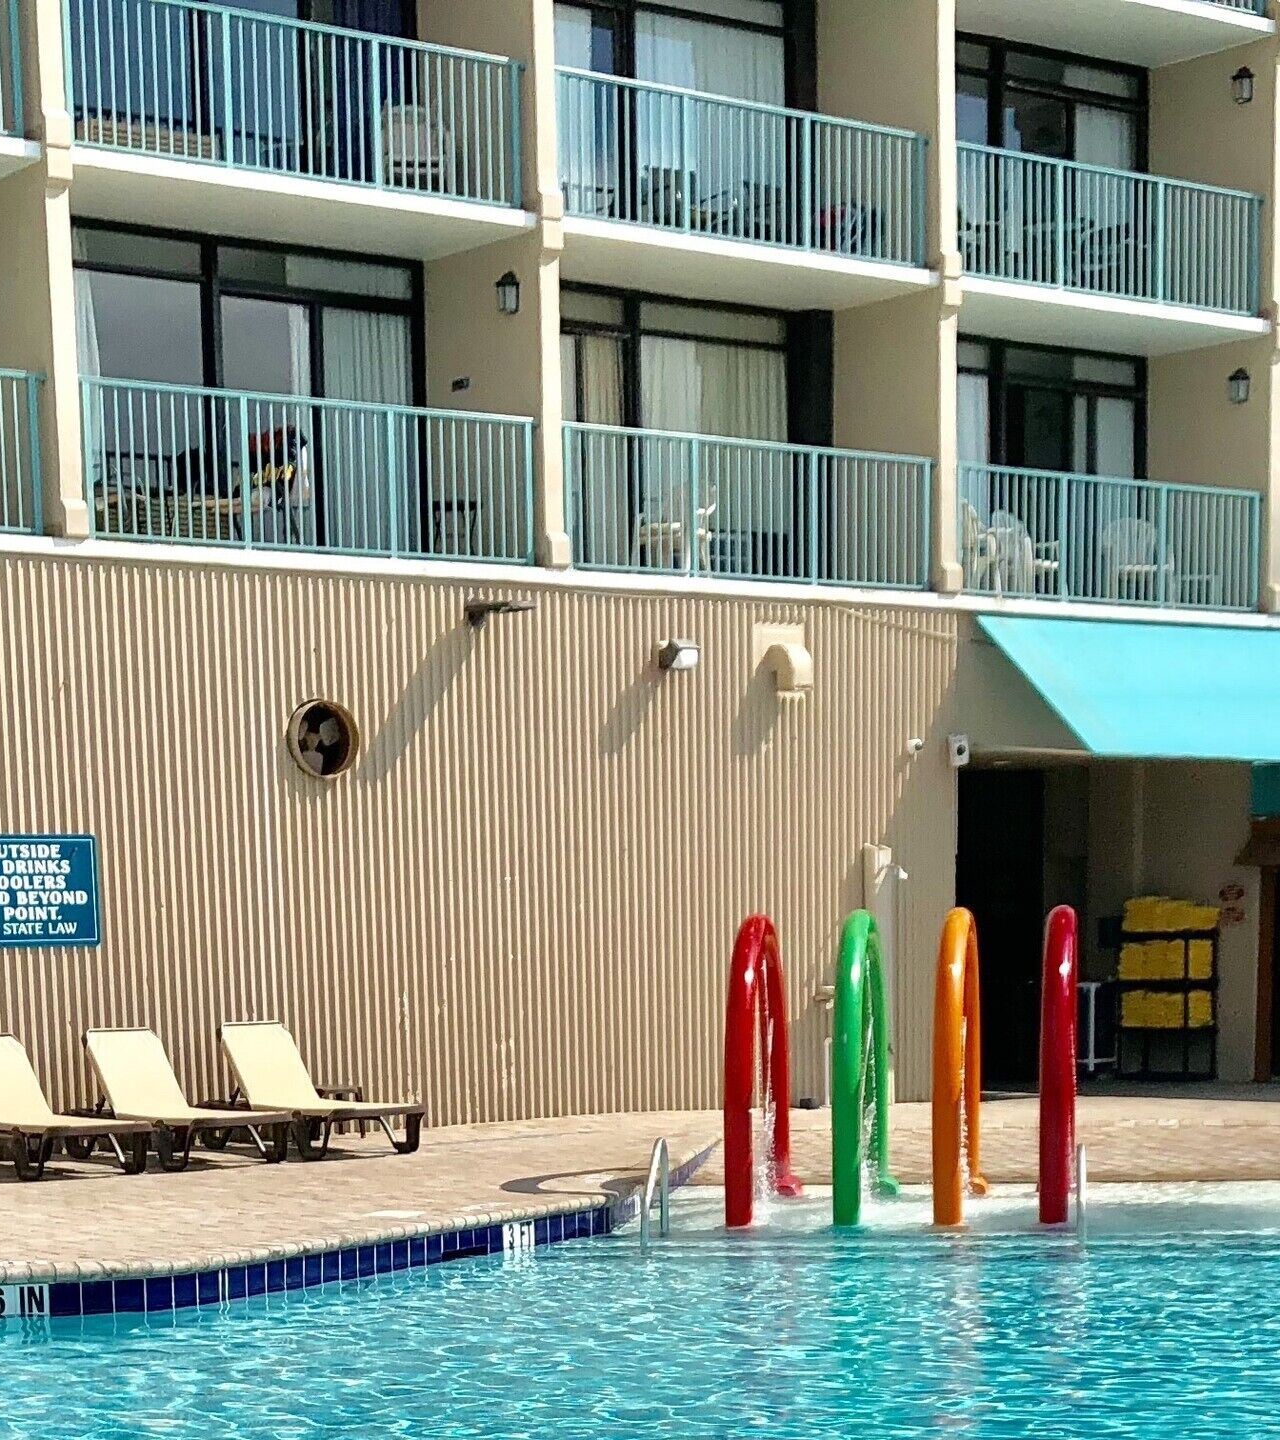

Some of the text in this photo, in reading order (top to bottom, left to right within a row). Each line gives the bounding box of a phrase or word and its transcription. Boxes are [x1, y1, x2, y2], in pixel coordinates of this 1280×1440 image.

[2, 859, 71, 875] DRINKS
[16, 890, 88, 905] BEYOND
[3, 906, 63, 921] POINT.
[3, 922, 44, 935] STATE
[48, 922, 78, 935] LAW
[508, 1220, 532, 1250] 3 FT
[19, 1285, 45, 1314] IN
